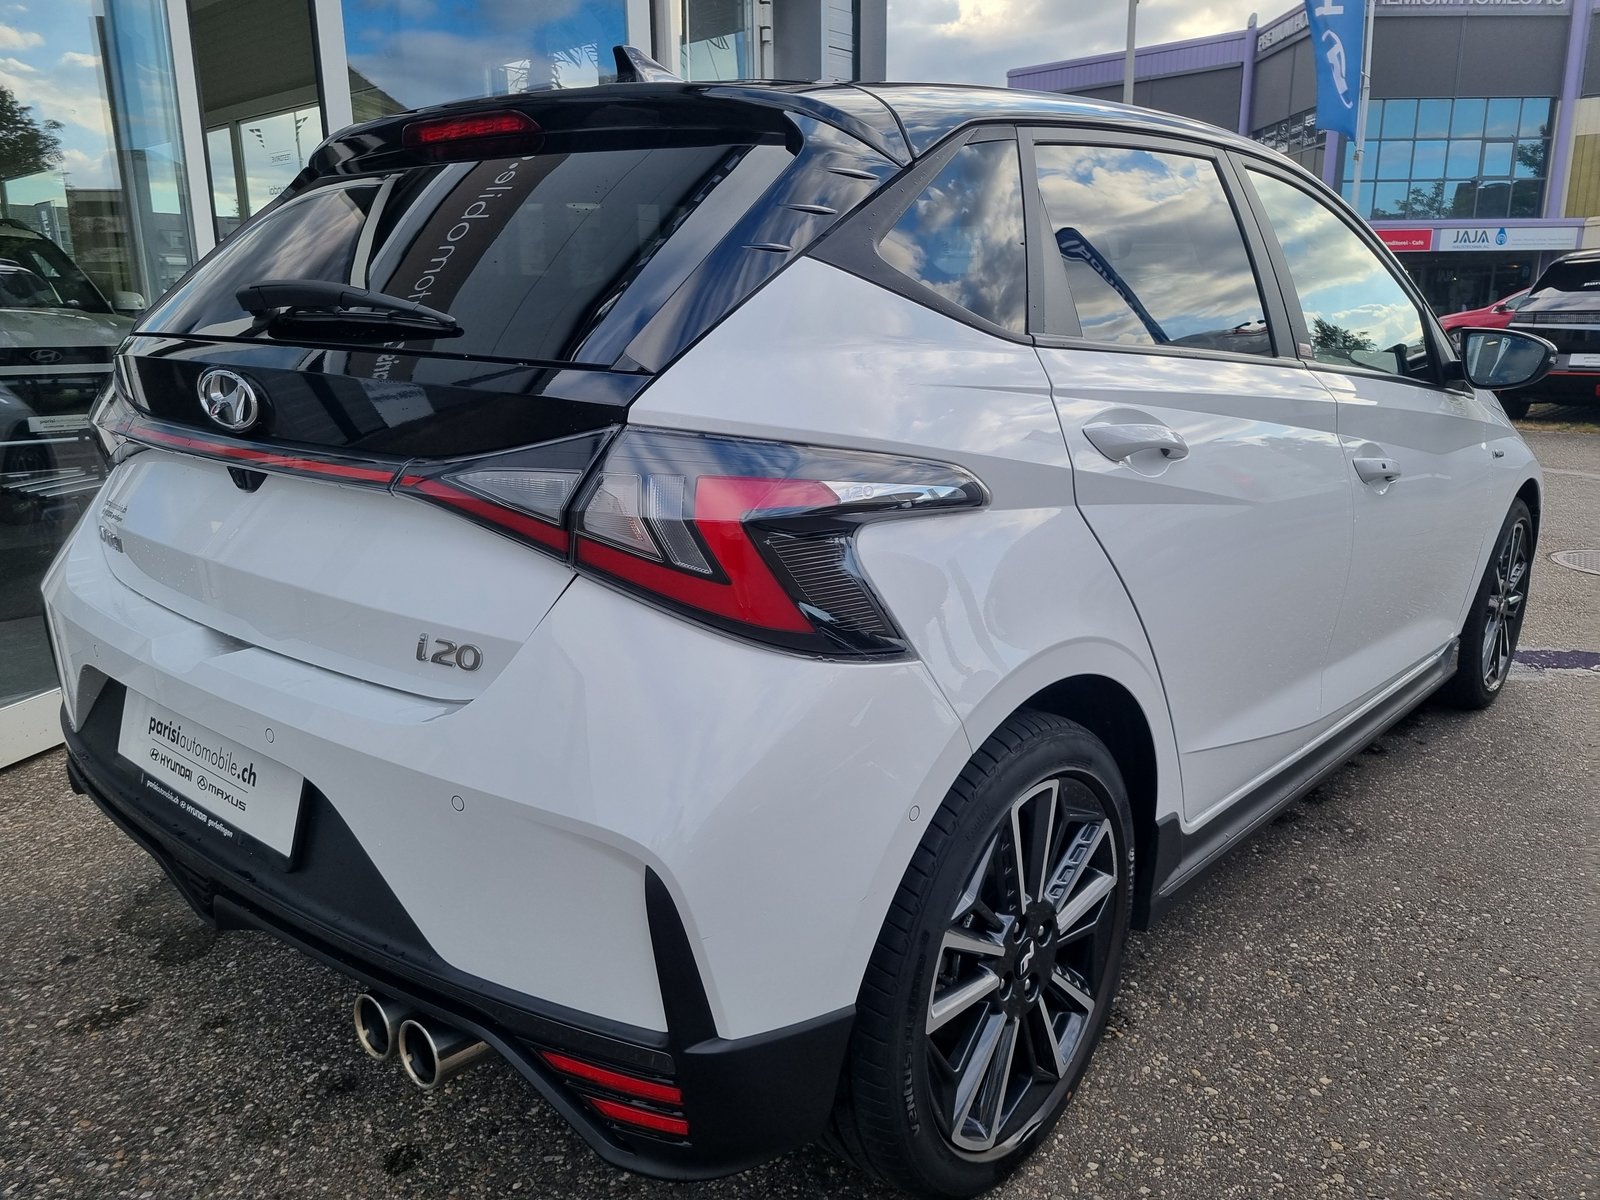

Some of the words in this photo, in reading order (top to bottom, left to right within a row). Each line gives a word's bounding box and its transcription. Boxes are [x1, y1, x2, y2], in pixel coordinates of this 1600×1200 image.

[1453, 230, 1489, 243] JAJA
[416, 632, 484, 672] i20
[148, 715, 257, 787] parisiautomobile.ch
[160, 753, 193, 782] HYUNDAI
[208, 784, 247, 812] MAXUS
[186, 803, 208, 823] HYUNDAI
